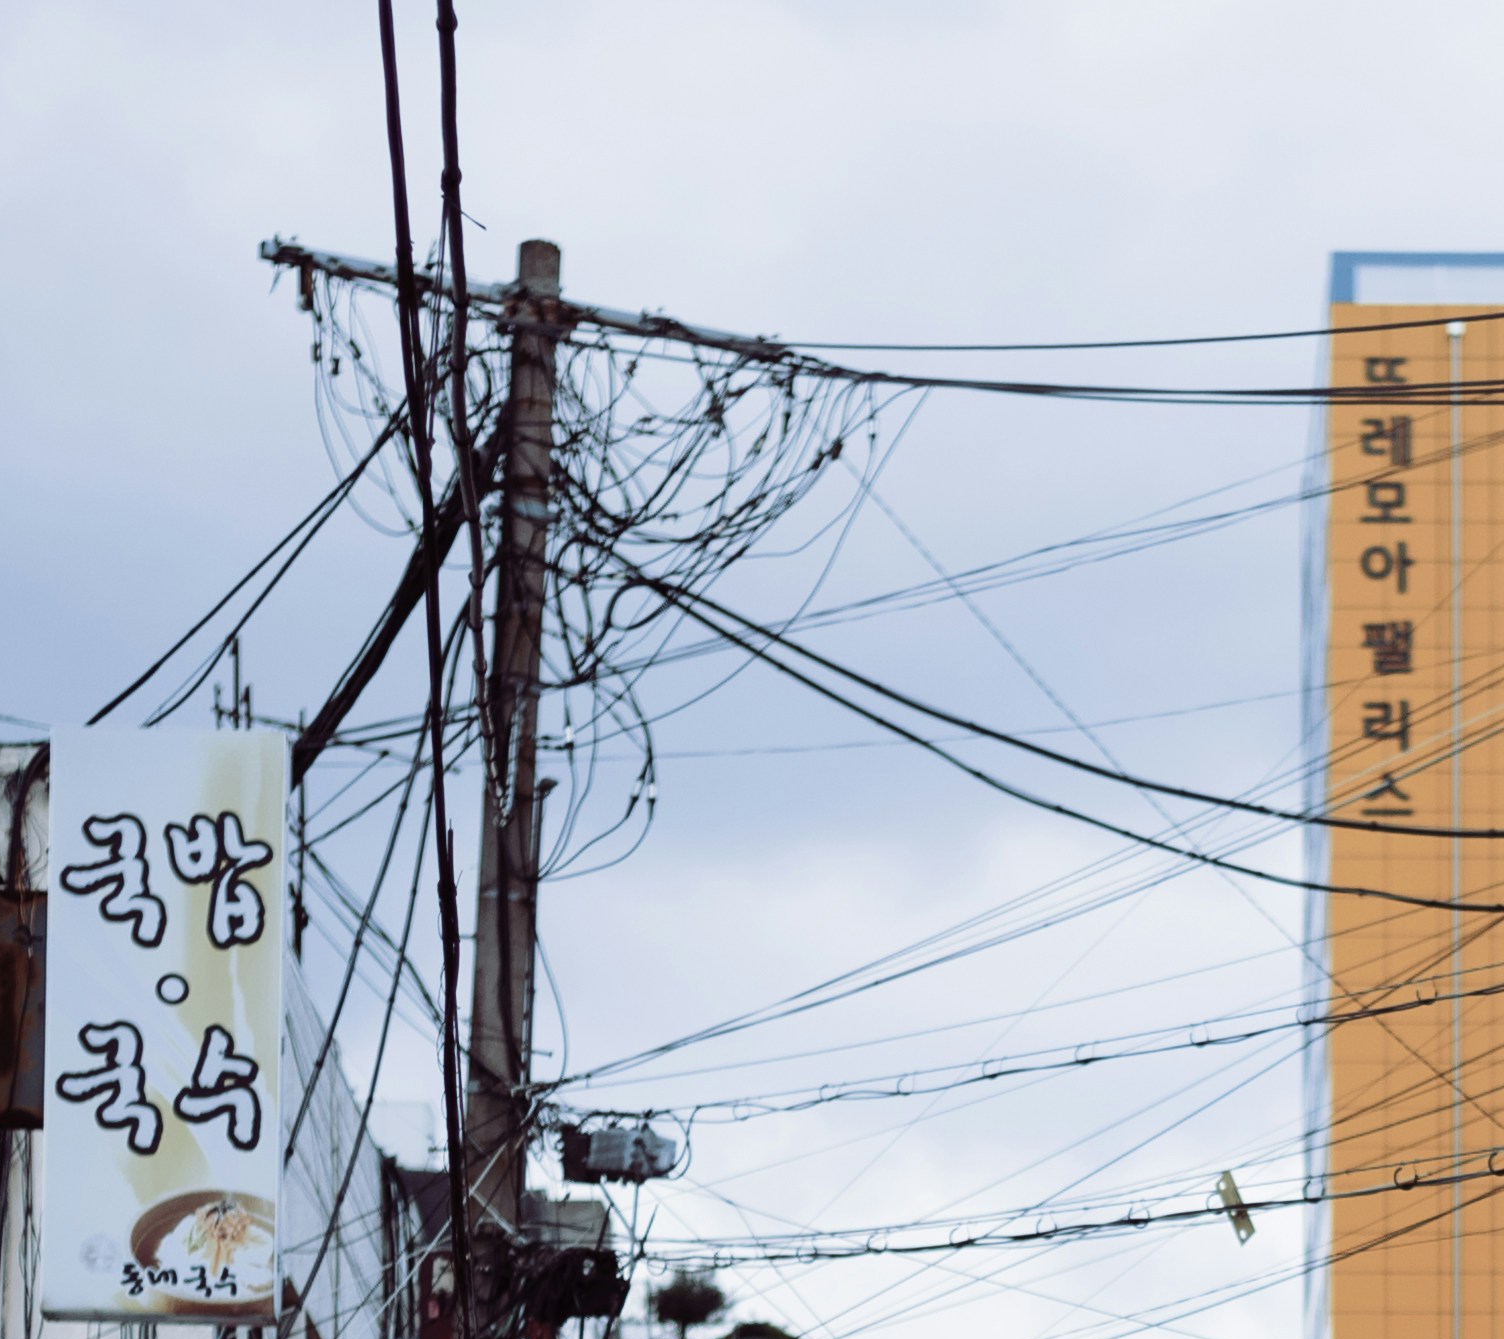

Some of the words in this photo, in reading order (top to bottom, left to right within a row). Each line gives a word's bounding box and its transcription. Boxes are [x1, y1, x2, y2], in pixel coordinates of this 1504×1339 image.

[61, 811, 273, 948] 국밥
[56, 1021, 261, 1156] 국수
[120, 1263, 177, 1298] 동네
[183, 1266, 238, 1297] 국수
